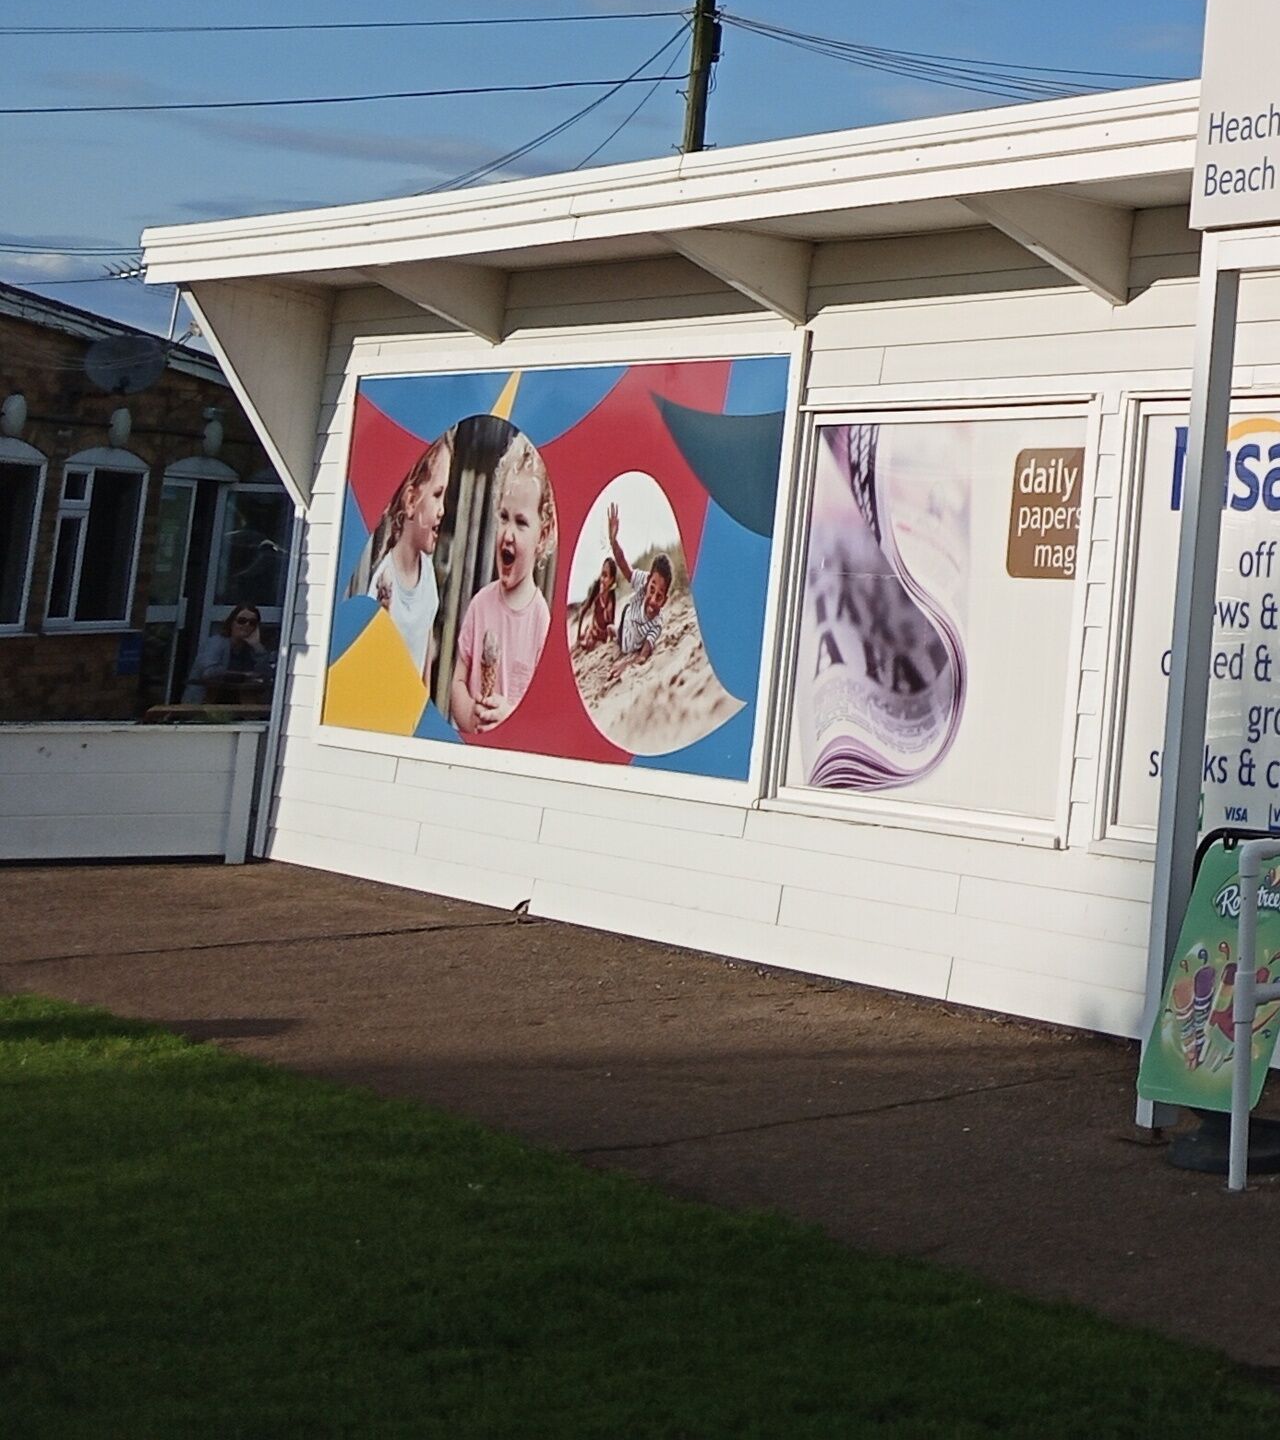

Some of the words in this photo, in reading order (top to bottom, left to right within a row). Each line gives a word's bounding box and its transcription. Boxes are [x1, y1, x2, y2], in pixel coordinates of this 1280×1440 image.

[1204, 156, 1275, 197] Beach
[1019, 458, 1078, 502] daily
[1017, 505, 1081, 537] papers
[1238, 541, 1275, 579] off
[1260, 593, 1278, 630] &
[1254, 644, 1272, 682] &
[1238, 748, 1256, 787] &
[1224, 806, 1248, 822] VISA
